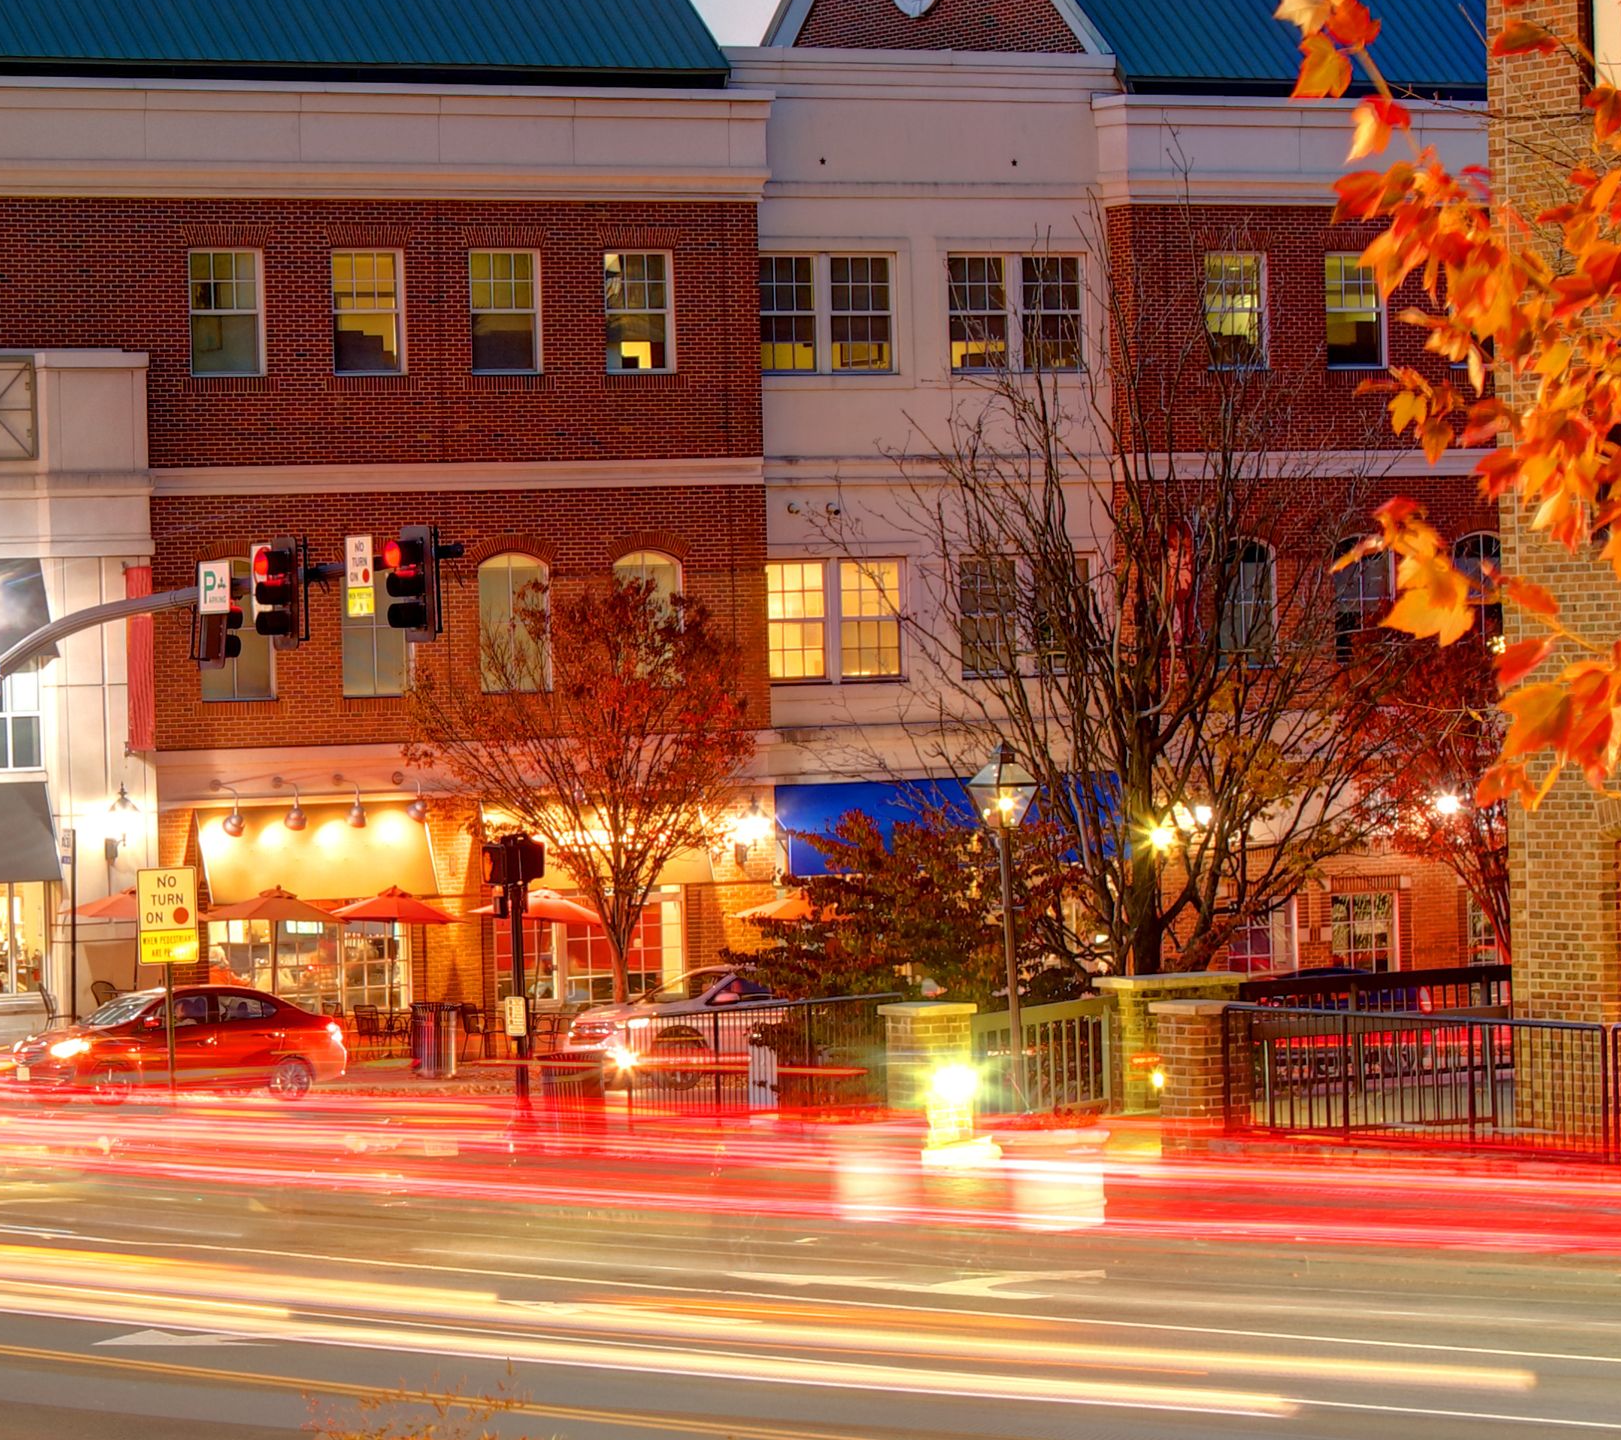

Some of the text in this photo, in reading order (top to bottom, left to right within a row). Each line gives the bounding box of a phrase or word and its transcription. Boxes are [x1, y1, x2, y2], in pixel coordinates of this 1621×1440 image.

[355, 543, 364, 552] NO
[157, 875, 176, 888] NO
[151, 893, 183, 906] TURN
[146, 911, 163, 924] ON
